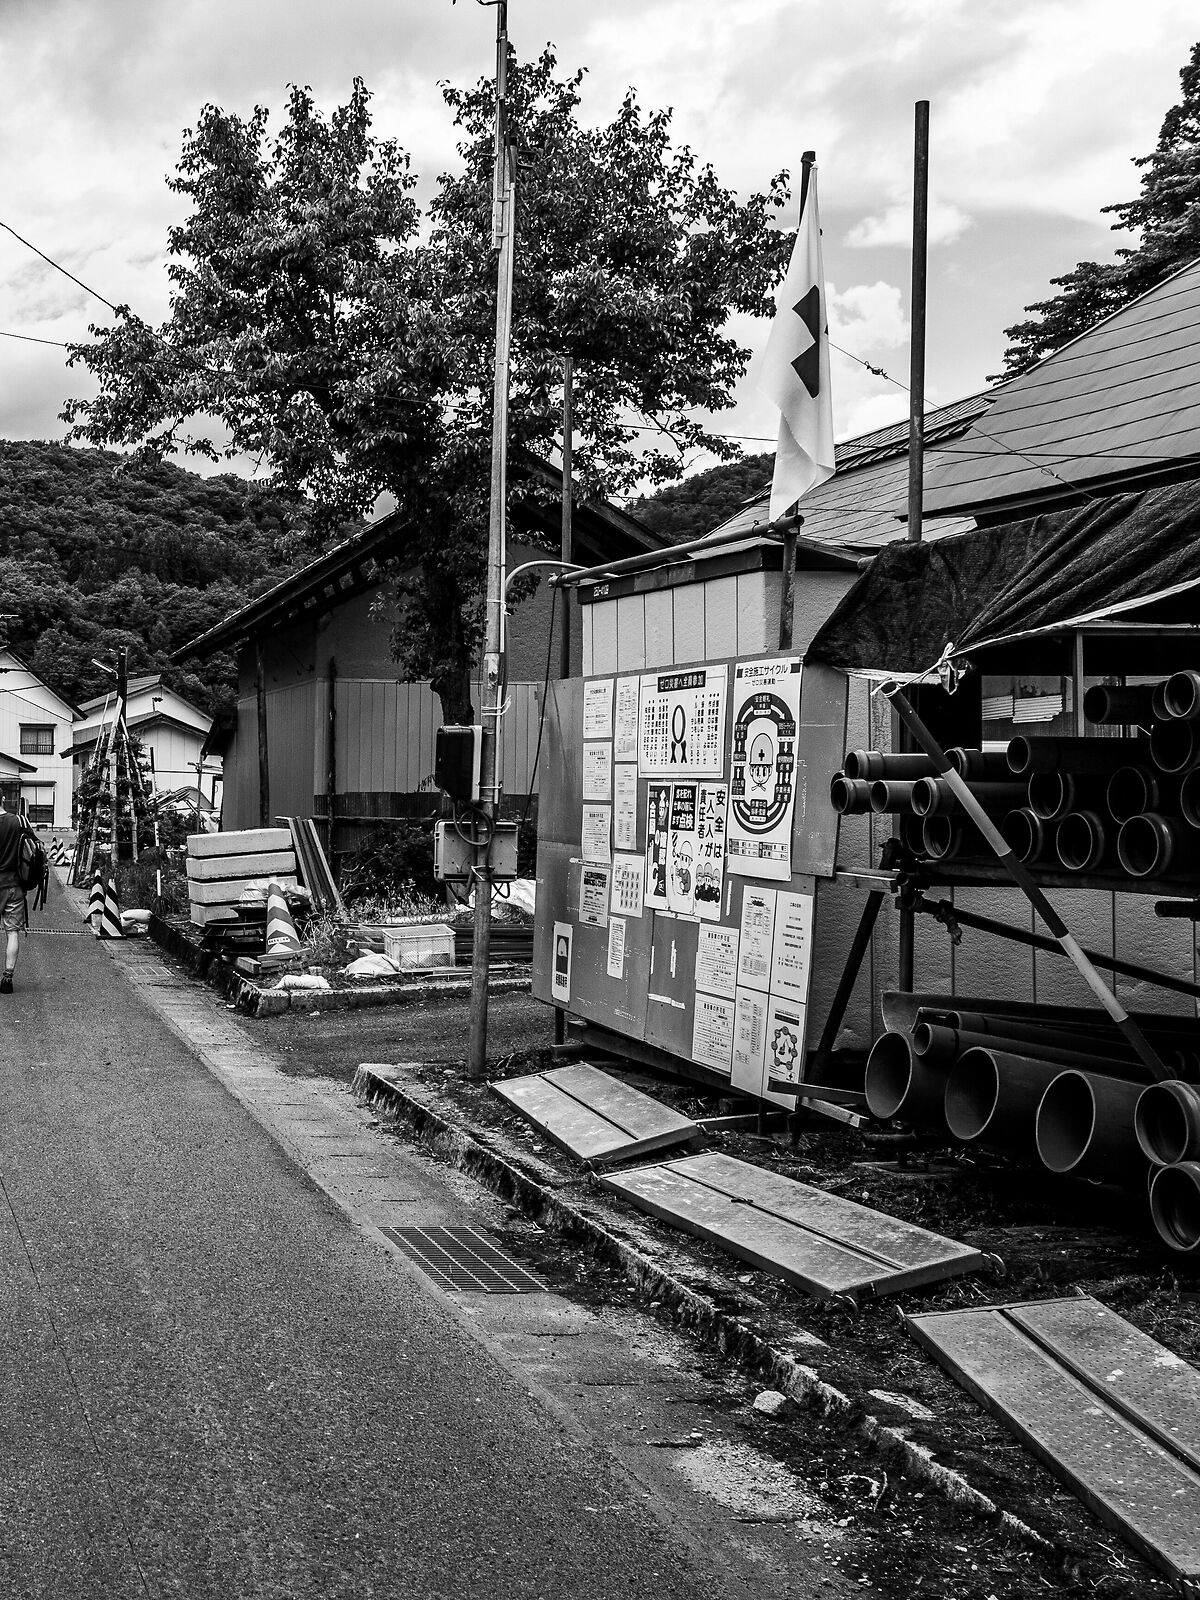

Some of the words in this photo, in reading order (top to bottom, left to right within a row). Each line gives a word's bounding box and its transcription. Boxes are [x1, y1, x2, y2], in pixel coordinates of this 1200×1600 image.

[659, 673, 704, 690] ゼロ災害へ全員参加
[744, 664, 788, 679] 安全施工サイクル
[705, 791, 716, 858] 一人一人が
[714, 789, 726, 859] 安全は
